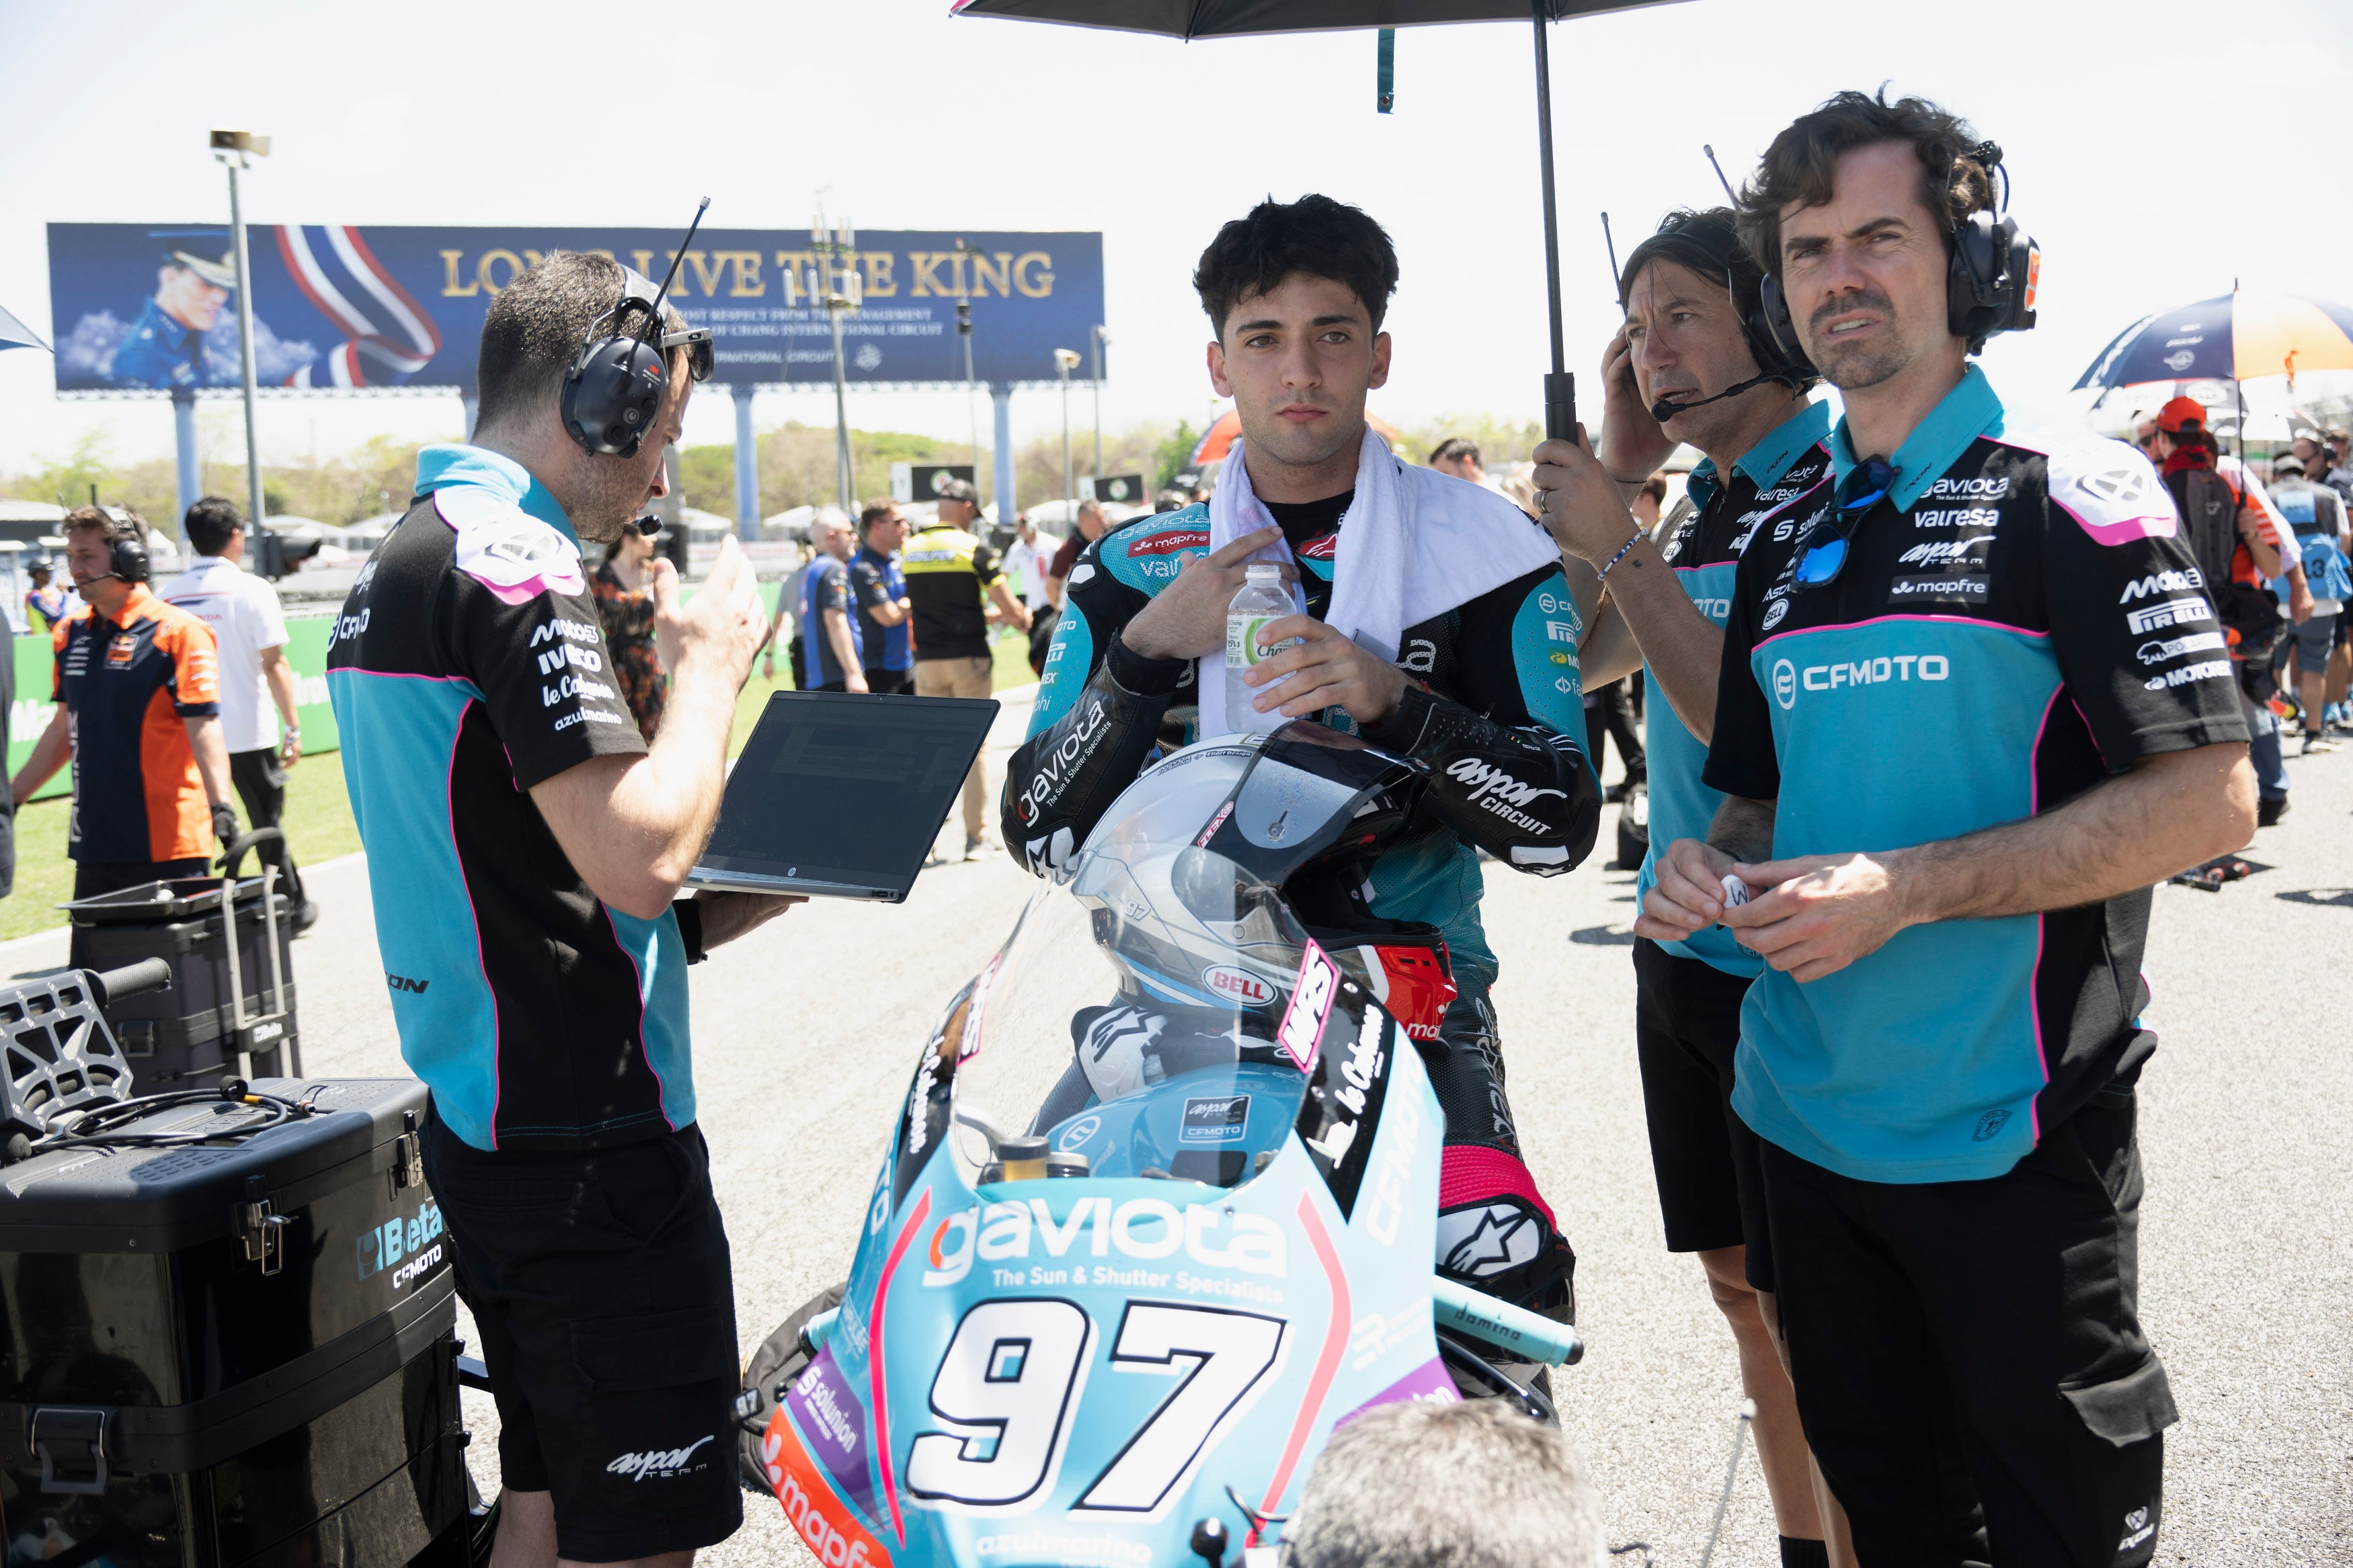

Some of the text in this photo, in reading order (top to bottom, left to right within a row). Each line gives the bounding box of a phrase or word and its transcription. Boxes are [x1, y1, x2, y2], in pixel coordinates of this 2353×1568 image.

[776, 249, 898, 297] THE
[909, 250, 1056, 298] KING
[1767, 450, 1789, 474] IXON
[1155, 534, 1207, 548] mapfre
[1916, 578, 1986, 594] mapfre
[1765, 606, 1783, 624] BELL
[538, 643, 602, 675] IVECO
[1803, 655, 1949, 692] CFMOTO
[1018, 700, 1105, 828] gaviota
[1046, 720, 1113, 807] The Sun & Shutter Specialists
[1479, 796, 1552, 835] CIRCUIT
[1124, 899, 1152, 921] 97
[1187, 1125, 1241, 1136] CFMOTO
[384, 1202, 443, 1268] Beta
[922, 1196, 1287, 1288] gaviota
[393, 1243, 442, 1288] CFMOTO
[992, 1265, 1284, 1305] The Sun & Shutter Specialists
[810, 1381, 858, 1454] solunion
[905, 1296, 1291, 1515] 97
